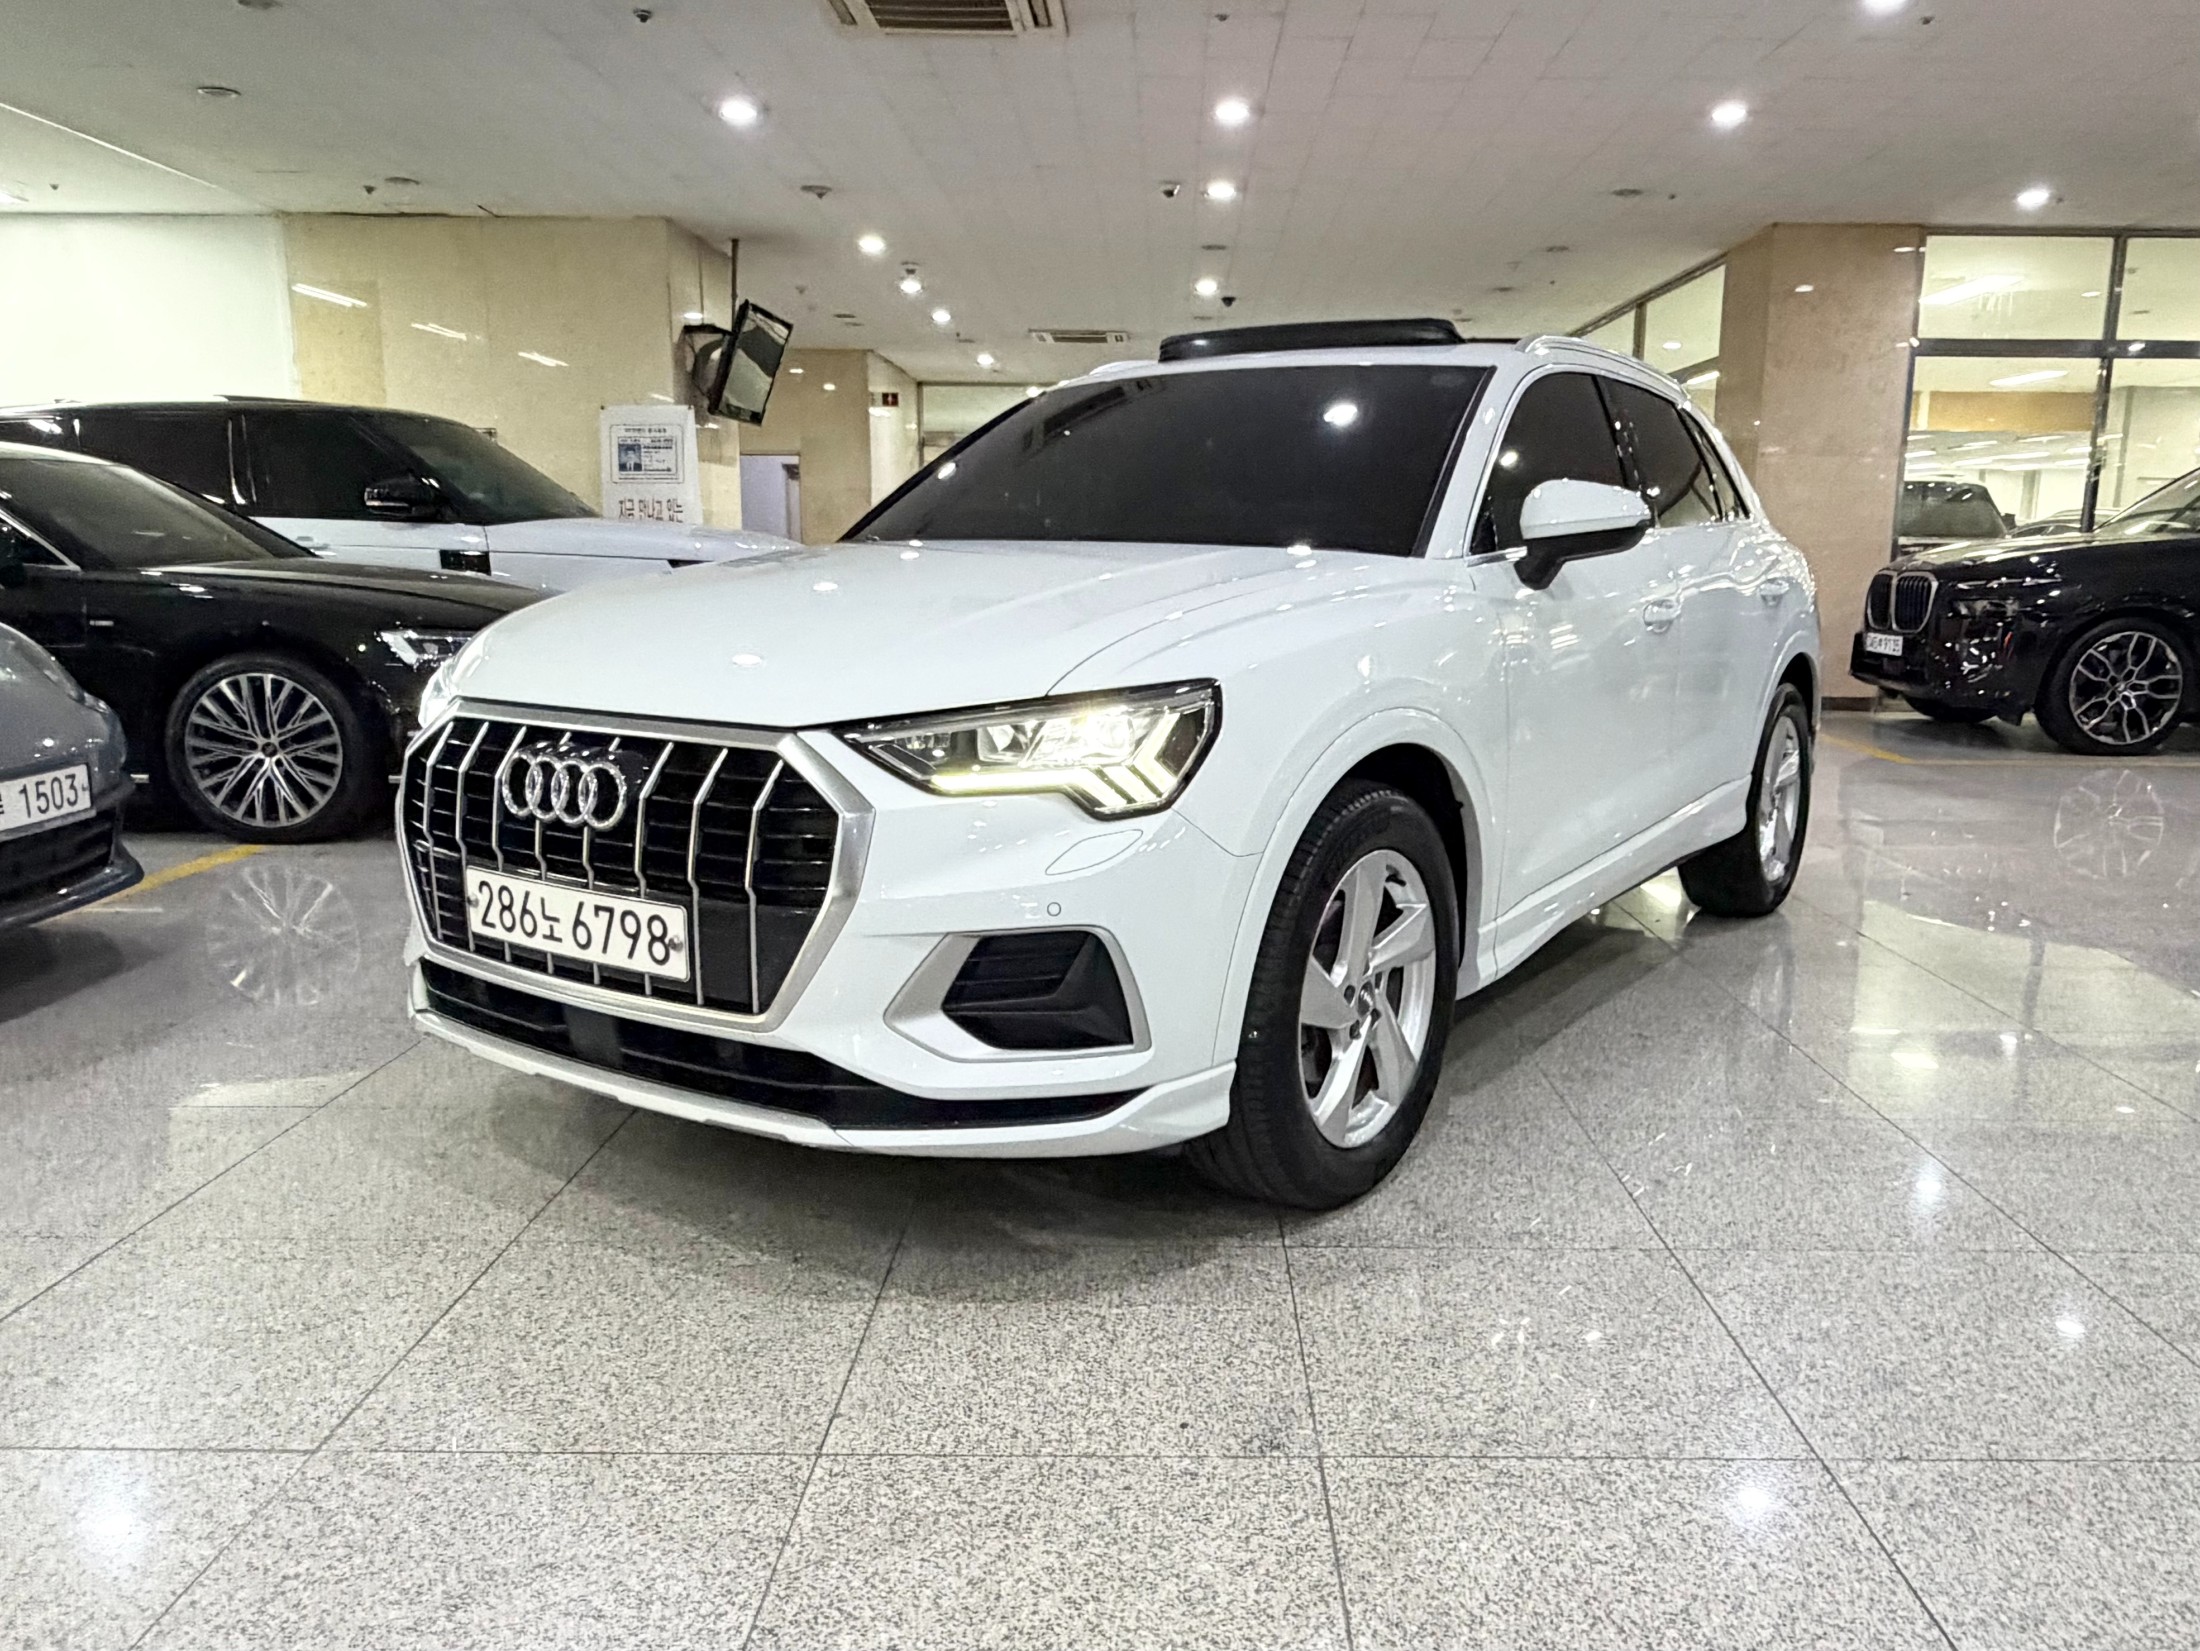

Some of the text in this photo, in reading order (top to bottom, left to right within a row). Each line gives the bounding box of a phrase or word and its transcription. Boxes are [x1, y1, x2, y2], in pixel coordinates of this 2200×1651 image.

[18, 773, 79, 818] 1503
[478, 880, 671, 966] 286노 6798
